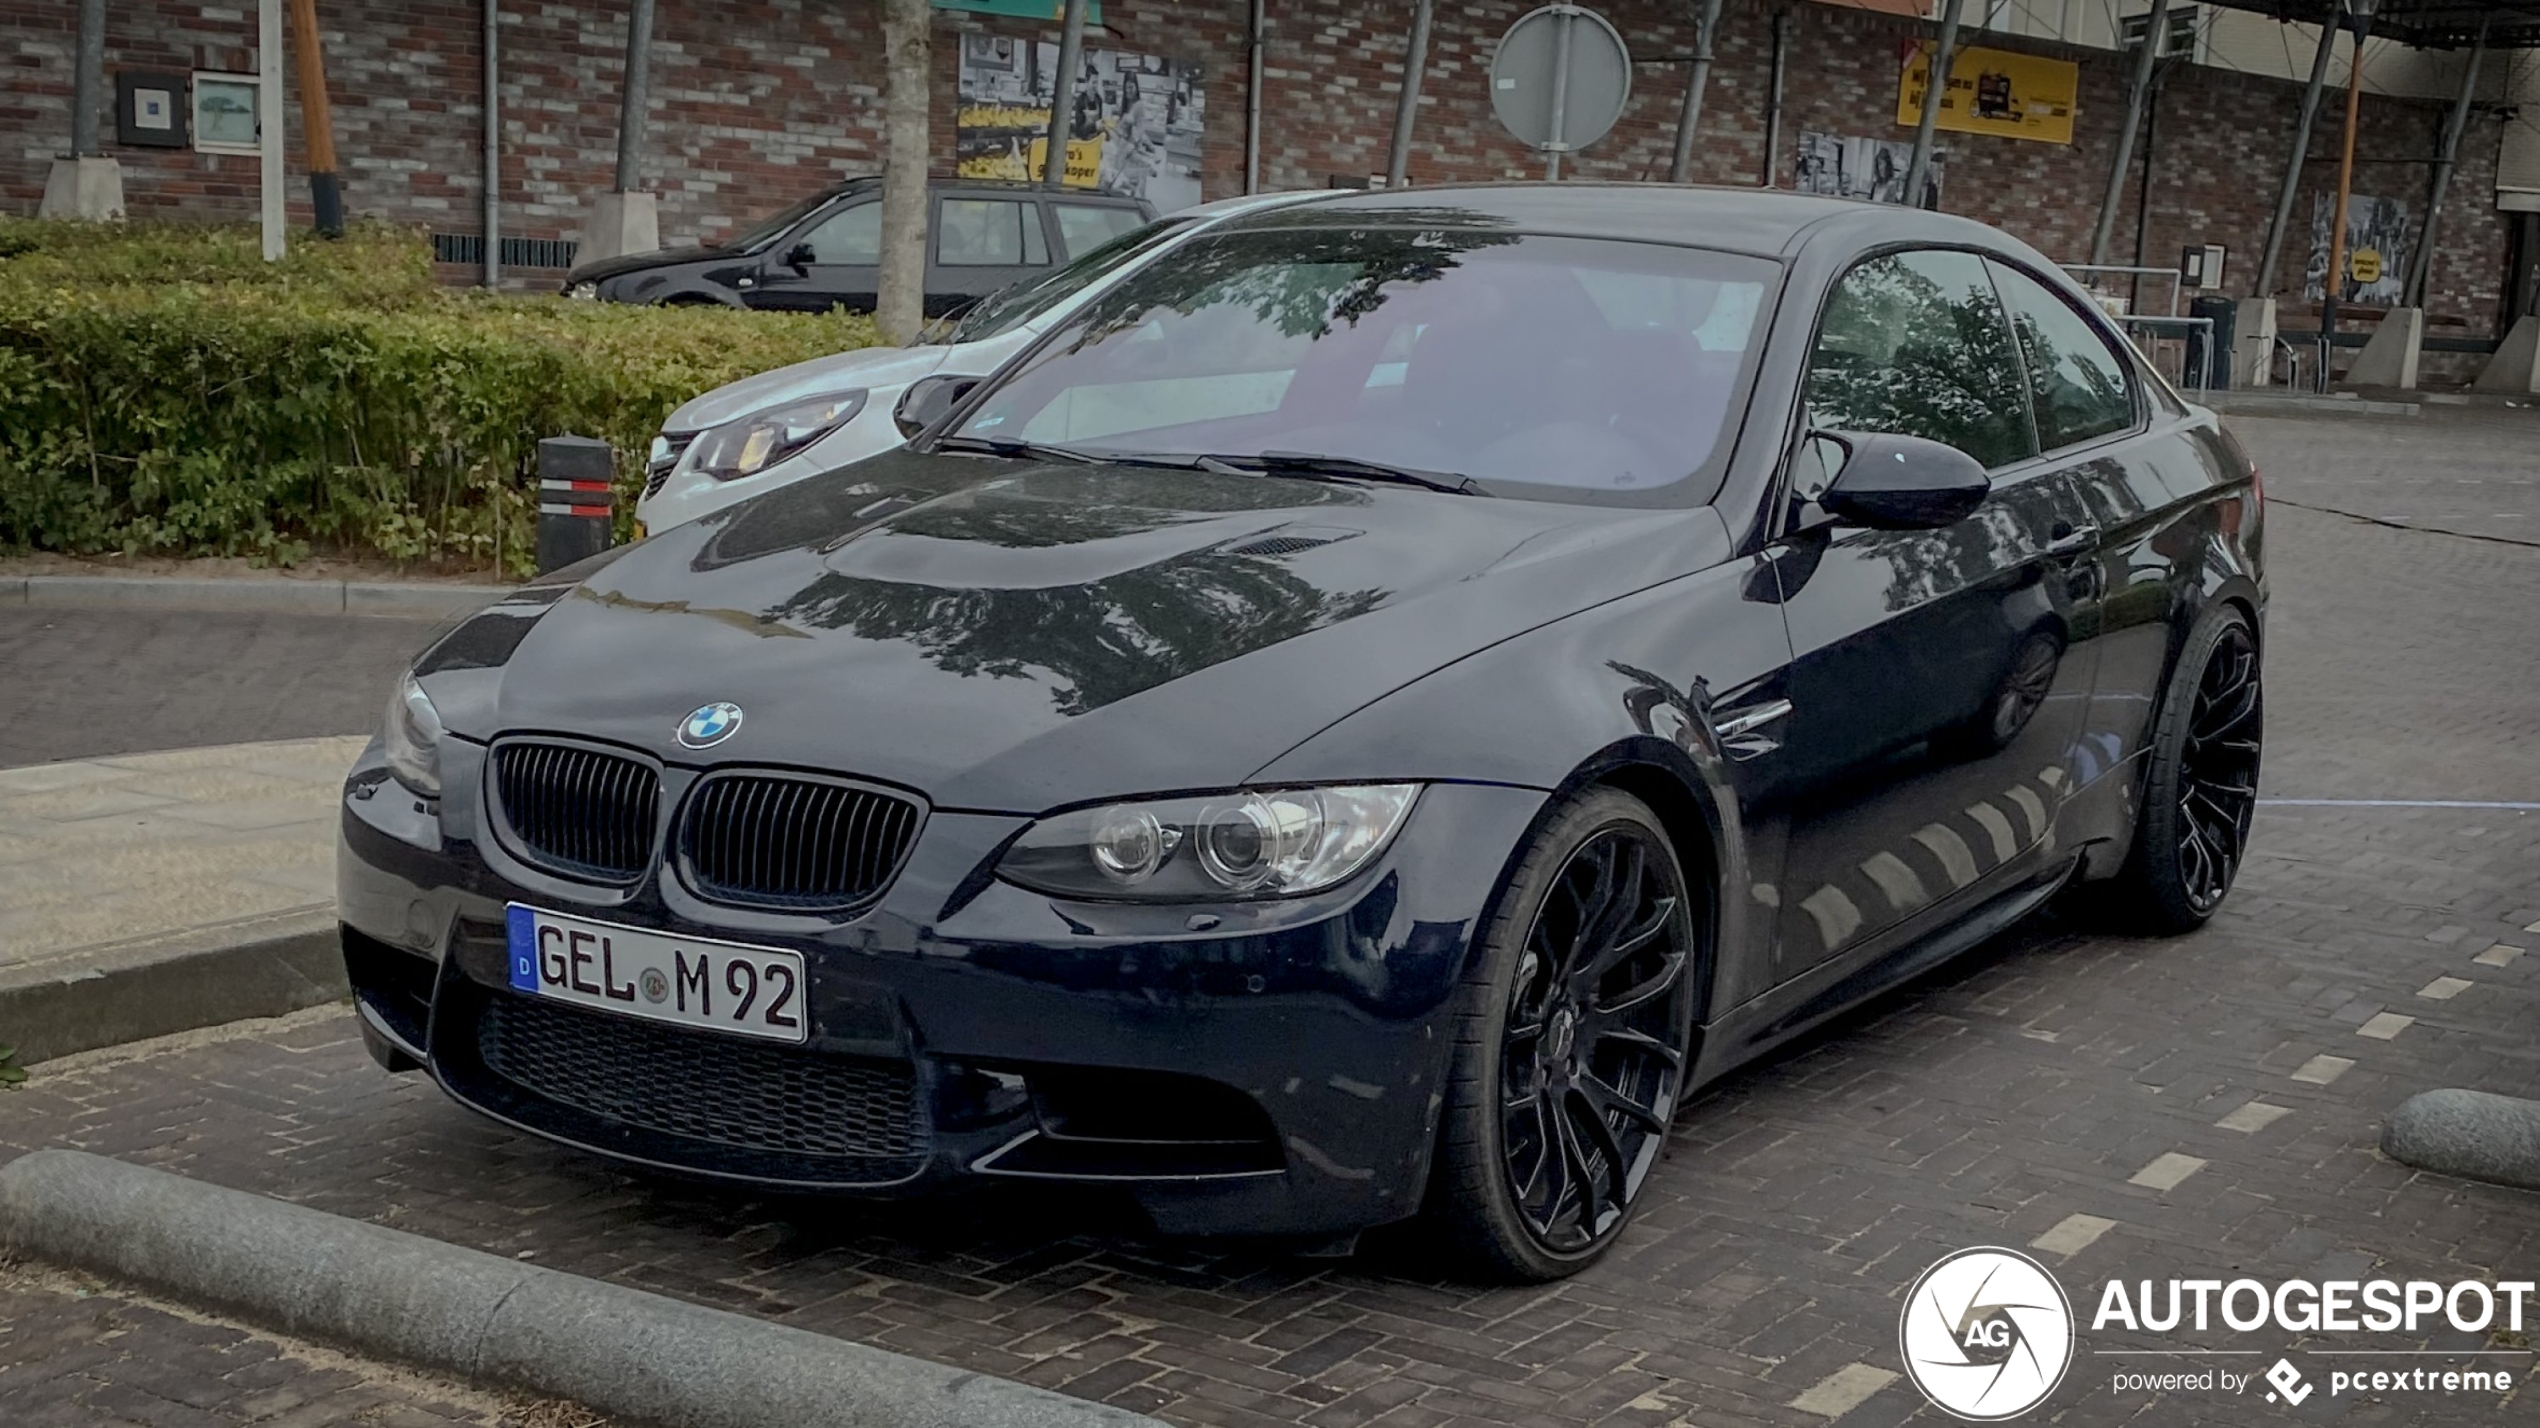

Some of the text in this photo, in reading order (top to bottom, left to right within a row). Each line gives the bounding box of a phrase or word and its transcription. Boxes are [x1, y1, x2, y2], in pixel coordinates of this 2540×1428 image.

[519, 957, 531, 976] D
[538, 924, 798, 1028] GEL M 92
